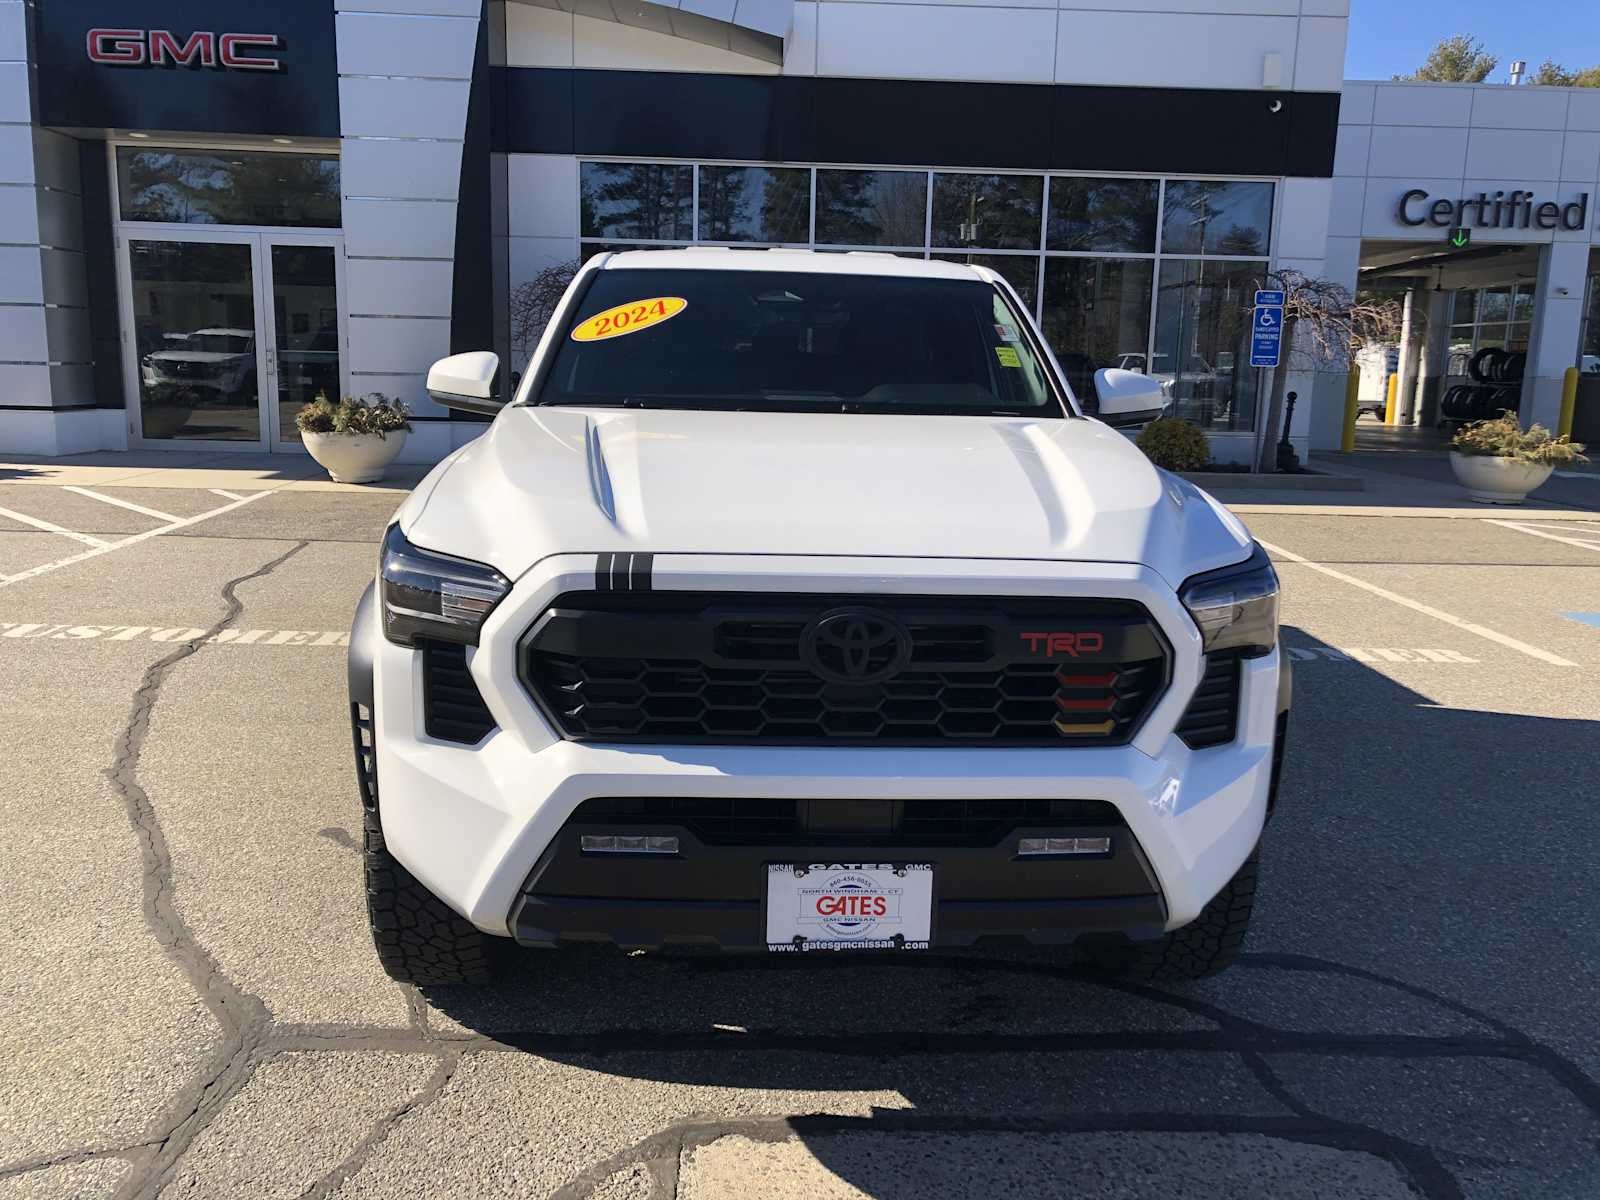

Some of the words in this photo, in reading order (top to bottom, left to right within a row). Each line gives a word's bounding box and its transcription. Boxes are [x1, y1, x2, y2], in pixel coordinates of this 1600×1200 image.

[86, 28, 280, 70] GMC
[1399, 189, 1589, 231] Certified
[594, 300, 667, 336] 2024
[1020, 632, 1104, 657] TRD
[768, 864, 794, 872] NISSAN
[808, 863, 894, 871] GATES
[816, 895, 887, 916] GATES
[768, 944, 799, 952] www.
[802, 940, 895, 952] gatesgmcnissan
[901, 942, 929, 950] .com
